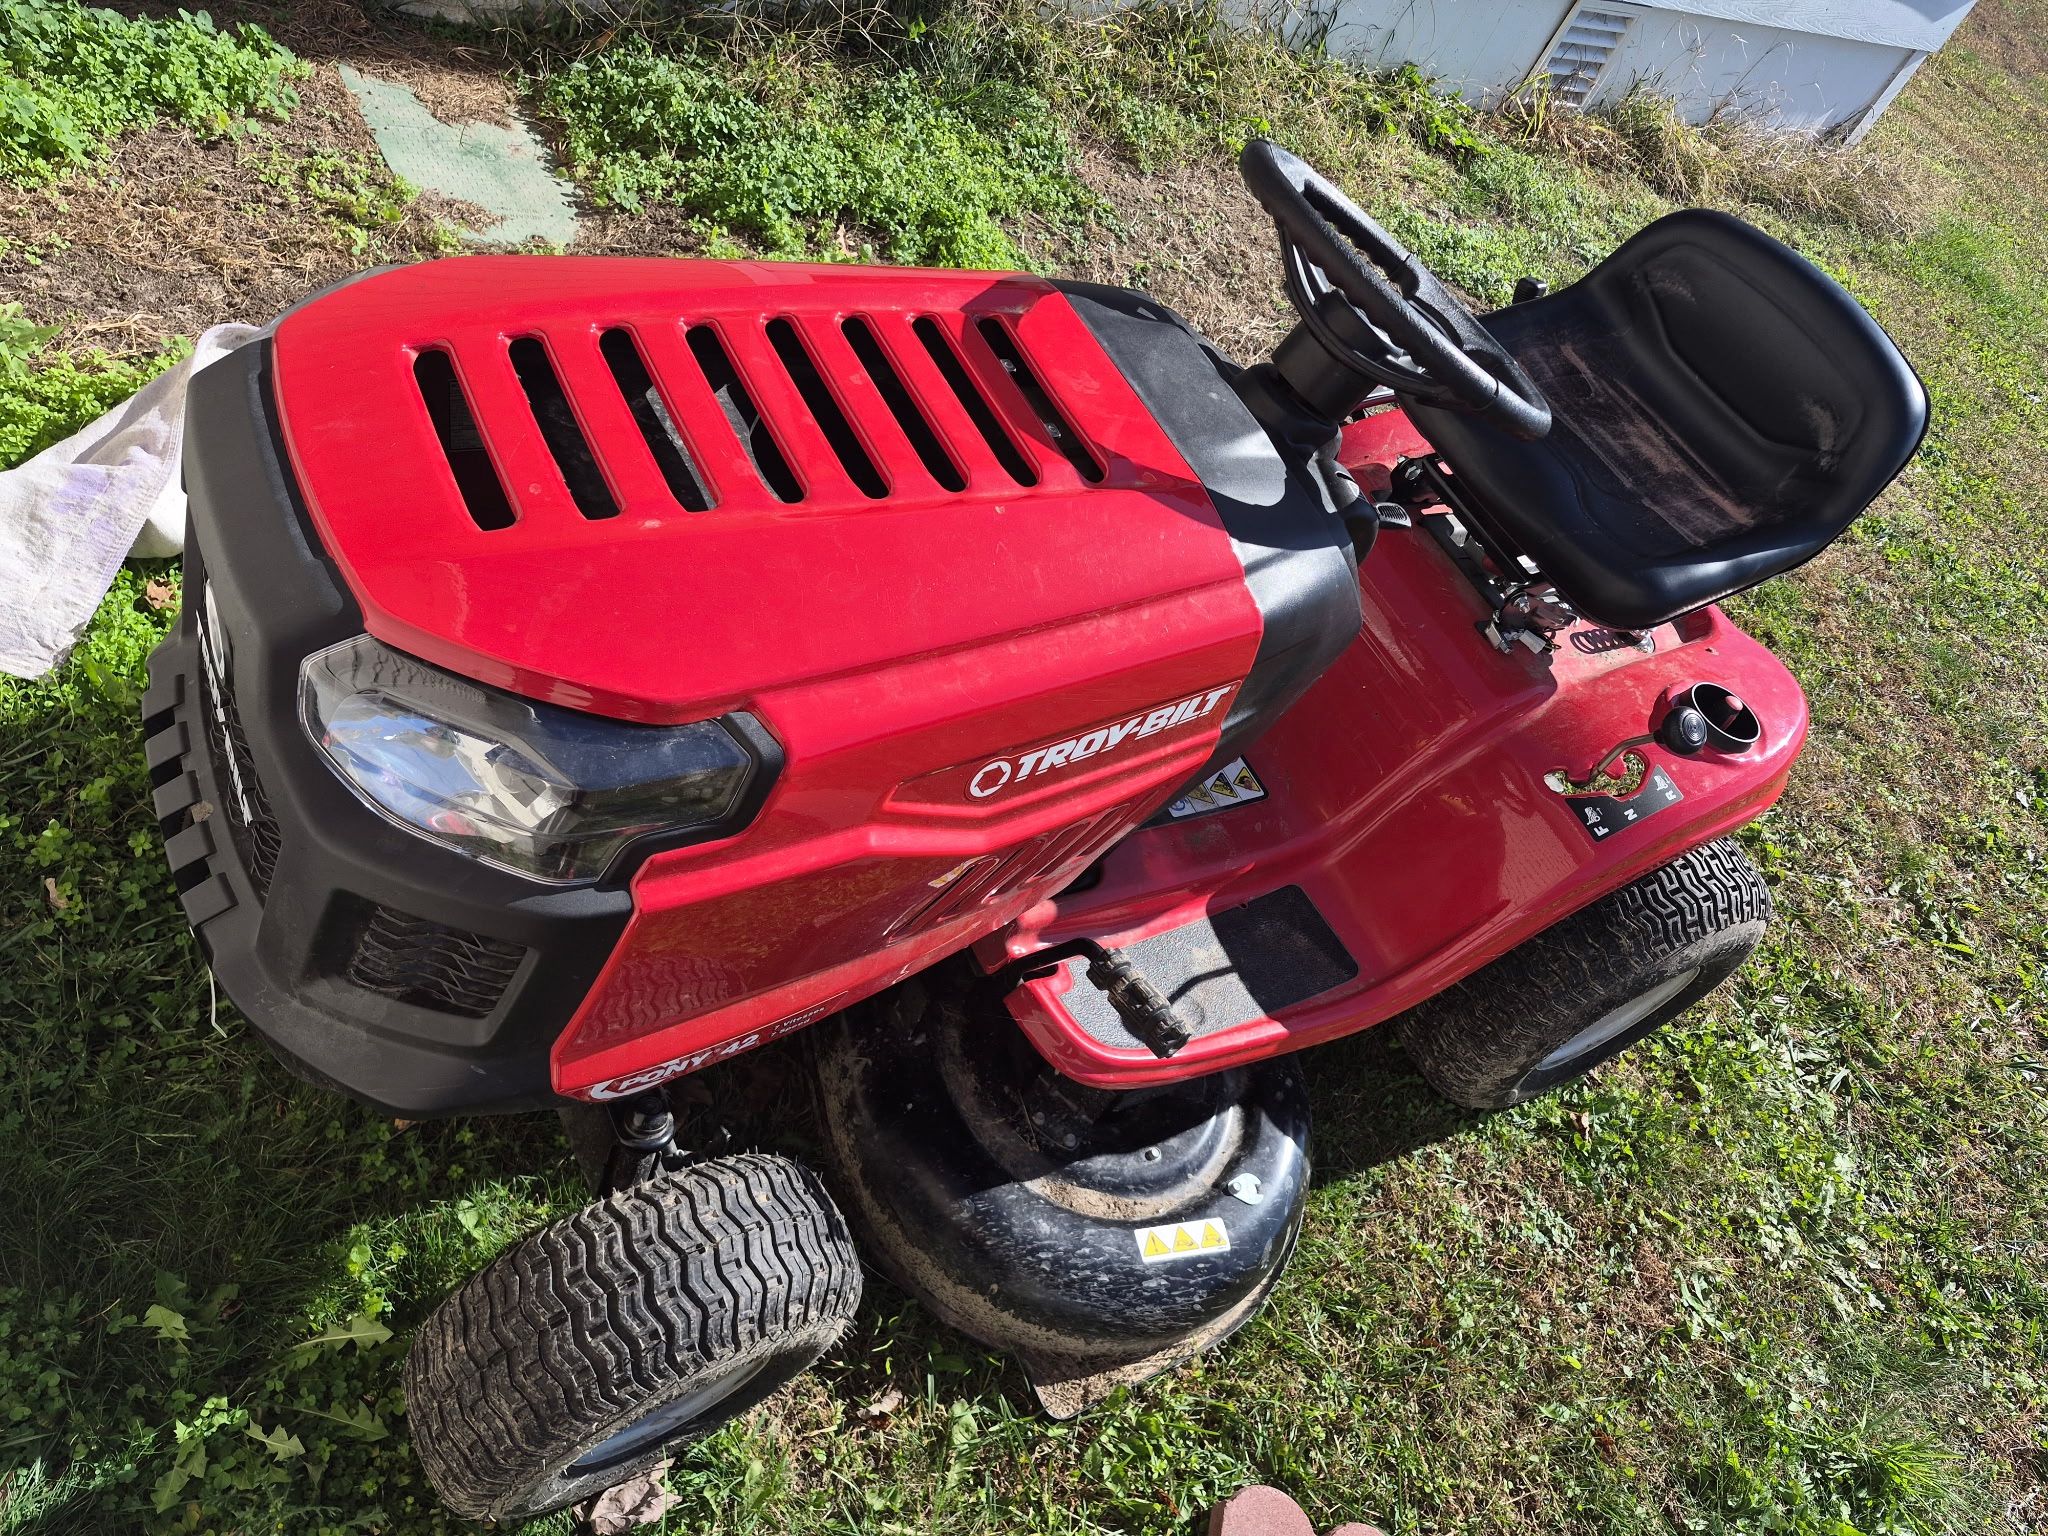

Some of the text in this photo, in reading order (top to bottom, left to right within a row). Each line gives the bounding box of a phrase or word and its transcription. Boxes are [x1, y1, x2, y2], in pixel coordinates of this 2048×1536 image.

[196, 610, 253, 827] TROY-BILT
[1014, 685, 1231, 783] TROY-BILT
[1665, 789, 1677, 801] R
[1593, 825, 1610, 837] F
[1623, 808, 1638, 821] N
[618, 1033, 760, 1091] PONY 42
